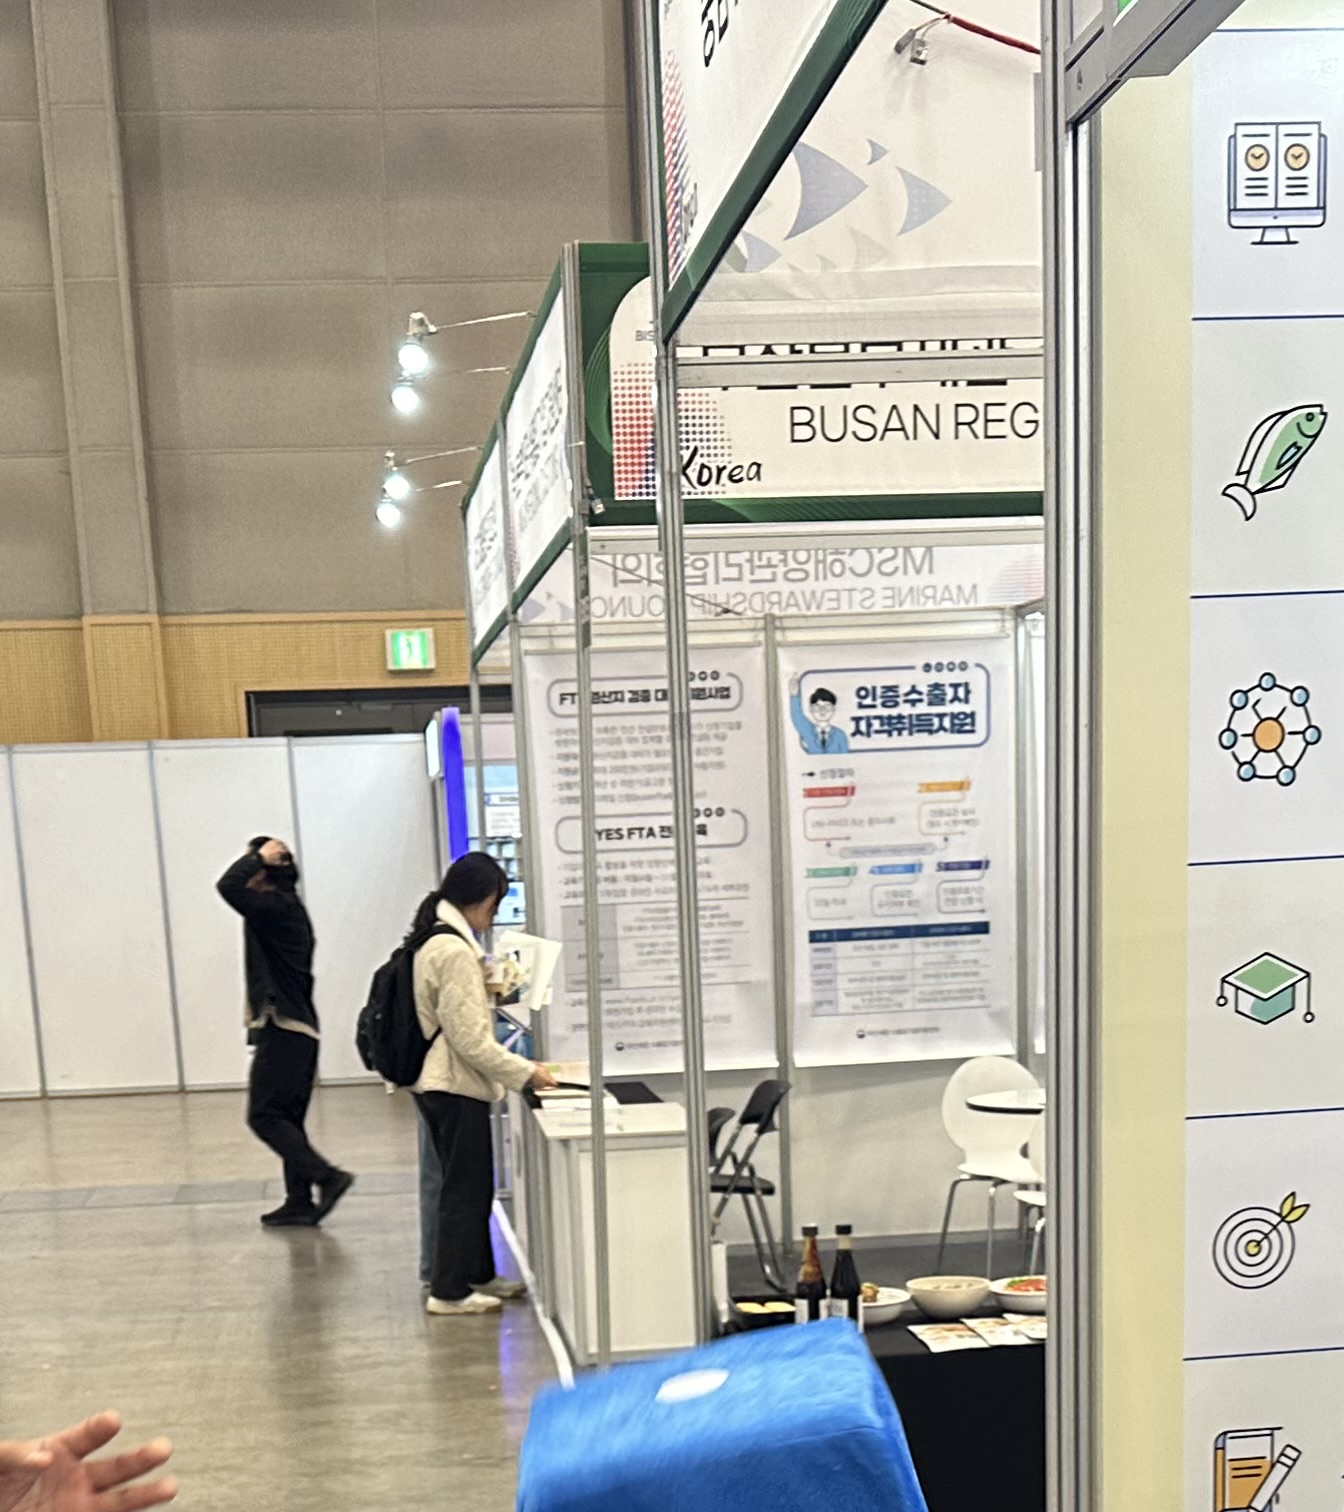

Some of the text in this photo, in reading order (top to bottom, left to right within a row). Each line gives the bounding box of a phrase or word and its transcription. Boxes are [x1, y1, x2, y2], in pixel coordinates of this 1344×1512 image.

[790, 404, 941, 442] BUSAN
[855, 683, 971, 709] 인증수출자
[850, 711, 976, 738] 자격취득지원
